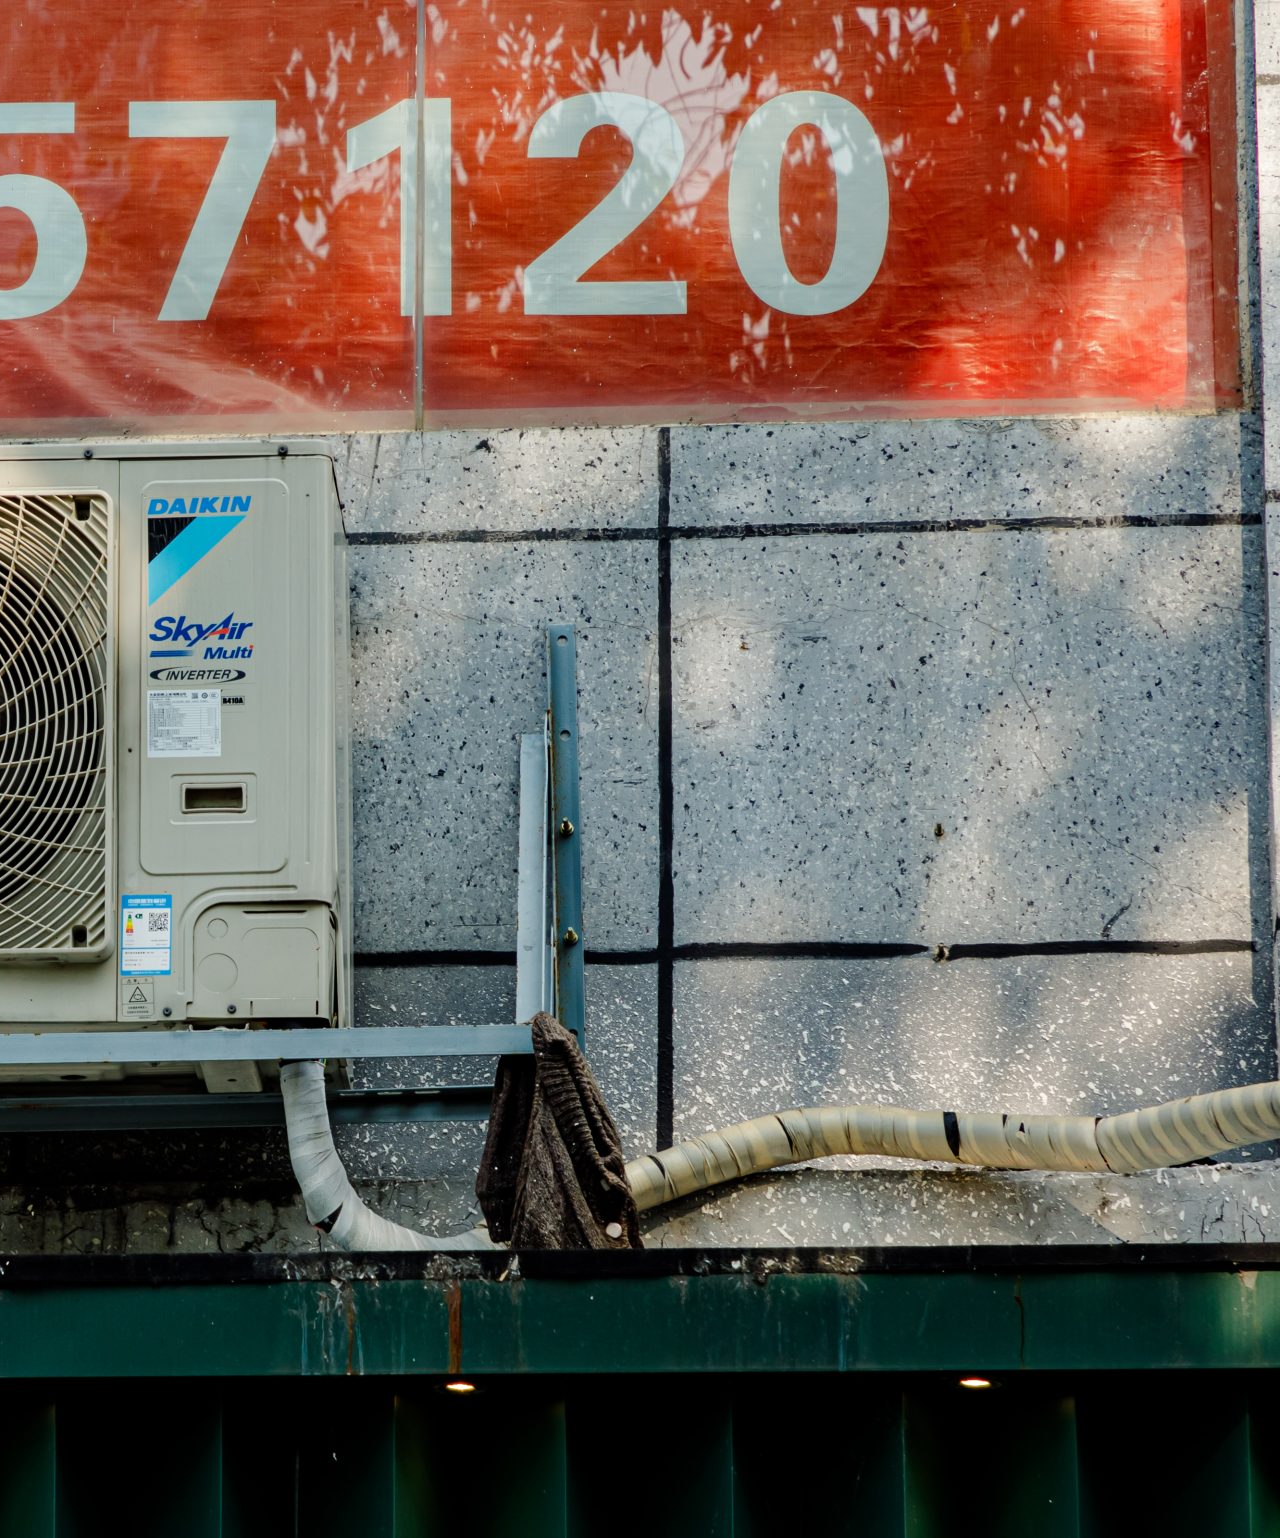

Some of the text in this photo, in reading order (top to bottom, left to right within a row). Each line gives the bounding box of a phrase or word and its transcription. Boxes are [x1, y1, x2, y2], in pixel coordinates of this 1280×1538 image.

[148, 495, 252, 515] DAIKIN
[203, 645, 254, 660] Multi
[165, 669, 232, 681] INVERTER
